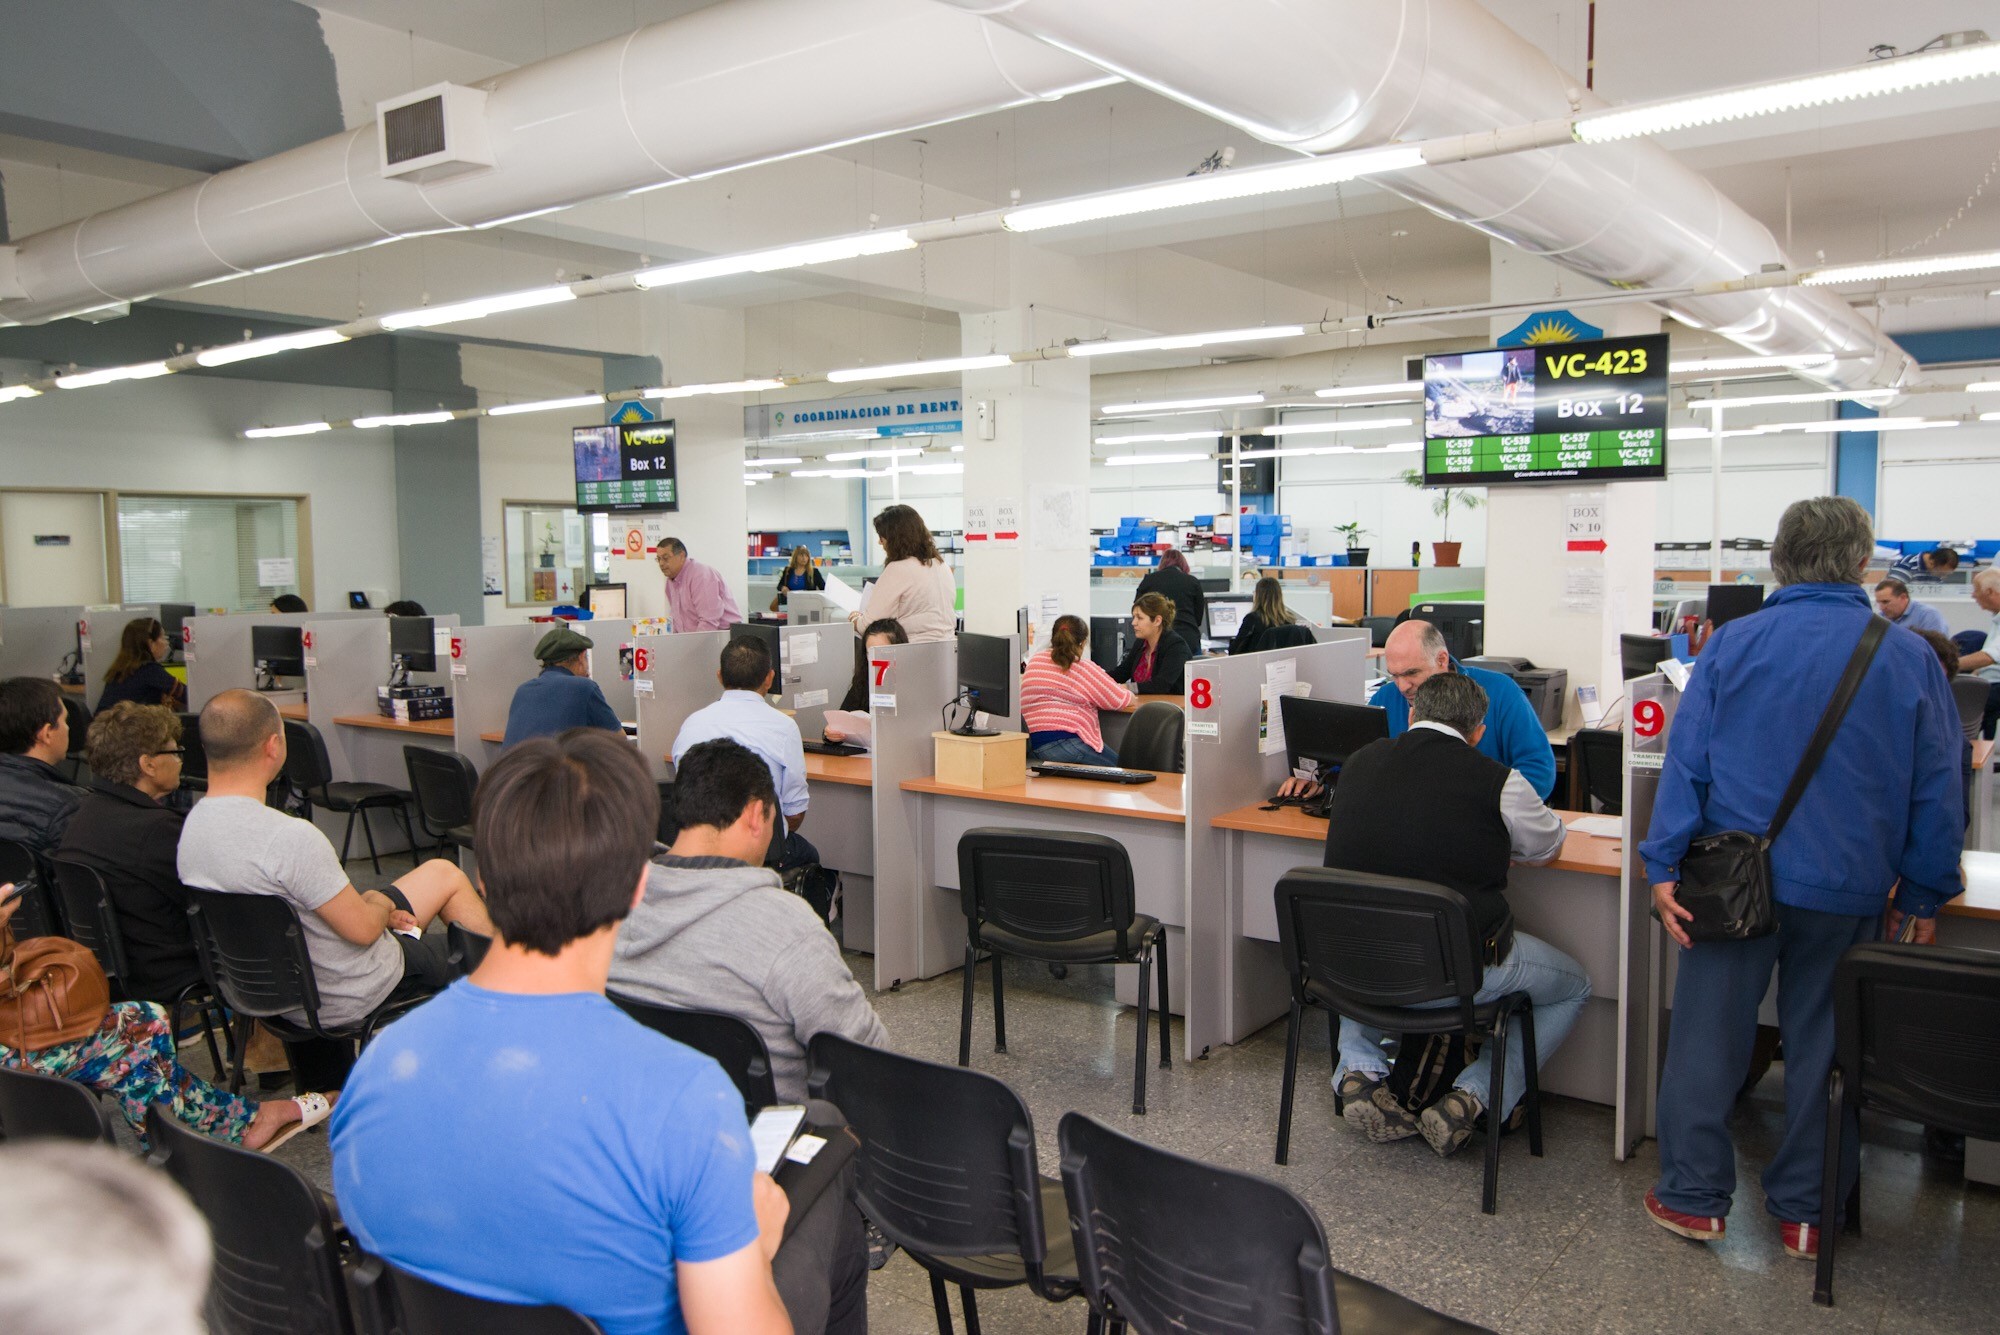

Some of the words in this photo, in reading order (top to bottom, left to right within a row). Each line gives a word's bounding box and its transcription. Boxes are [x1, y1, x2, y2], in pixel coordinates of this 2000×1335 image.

[1545, 348, 1648, 378] VC-423
[794, 406, 890, 423] COORDINACION
[896, 404, 914, 416] DE
[1557, 399, 1602, 418] Box
[1616, 394, 1644, 414] 12
[624, 430, 666, 446] VC-423
[1501, 436, 1531, 446] IC-538
[1560, 432, 1591, 443] IC-537
[1618, 429, 1655, 440] CA-043
[1445, 439, 1474, 448] IC-539
[1499, 454, 1532, 463] VC-422
[1557, 451, 1592, 461] CA-042
[1618, 448, 1654, 459] VC-421
[630, 458, 650, 471] Box
[654, 456, 666, 470] 12
[1445, 457, 1474, 466] IC-536
[1573, 508, 1599, 518] BOX
[1569, 523, 1584, 533] N°
[1588, 523, 1601, 532] 10
[80, 620, 87, 635] 2
[182, 627, 191, 643] 3
[302, 631, 312, 649] 4
[451, 638, 462, 658] 5
[635, 648, 648, 672] 6
[872, 660, 891, 686] 7
[1190, 678, 1212, 709] 8
[1633, 700, 1665, 737] 9
